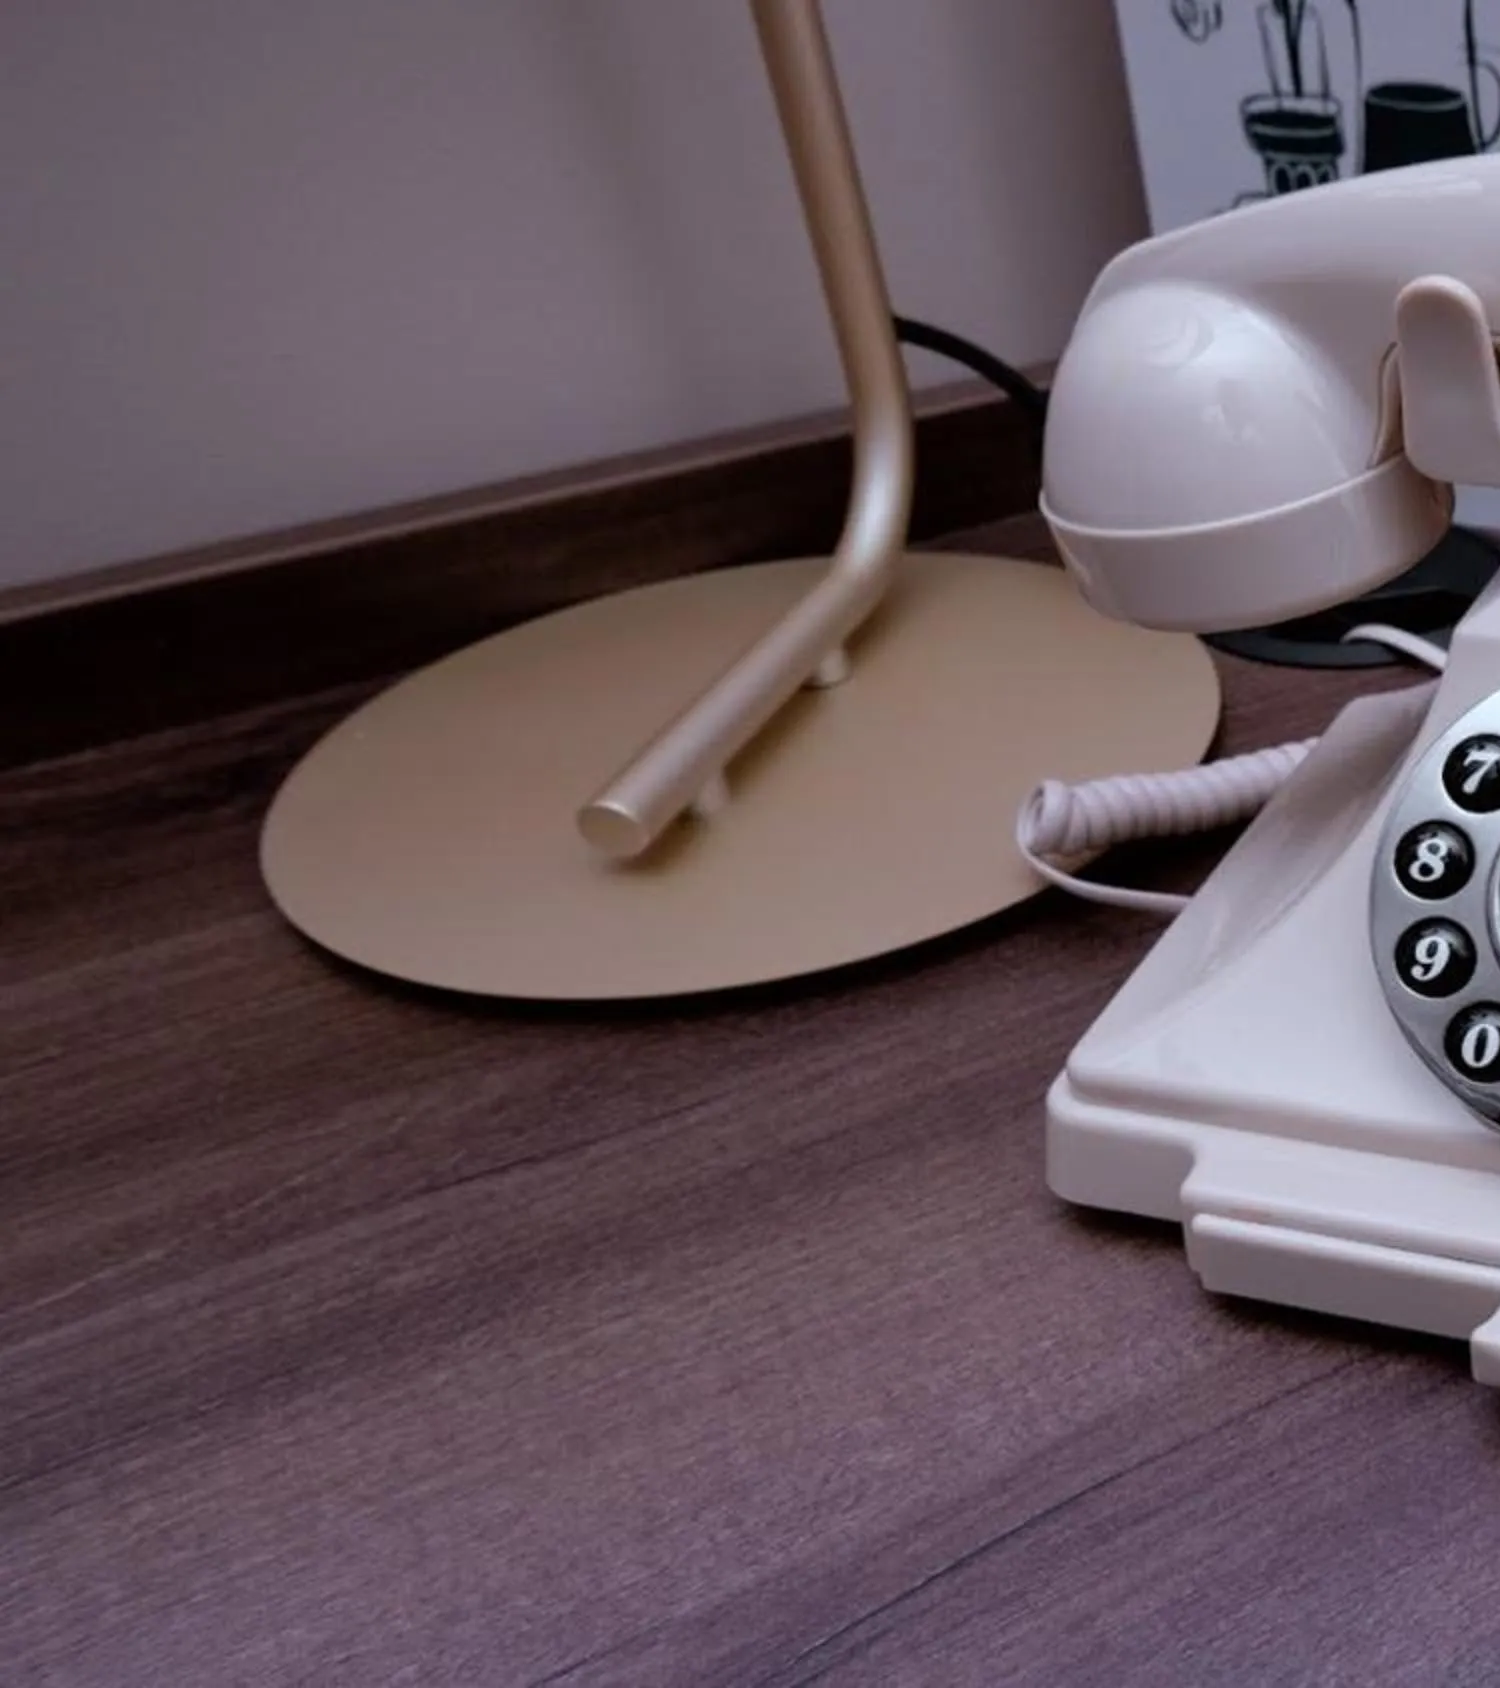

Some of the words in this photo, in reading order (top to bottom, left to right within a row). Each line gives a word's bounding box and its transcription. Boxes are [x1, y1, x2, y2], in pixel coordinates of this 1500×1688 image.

[1463, 749, 1500, 794] 7
[1409, 837, 1448, 882] 8
[1410, 935, 1451, 981] 9
[1461, 1023, 1500, 1069] 0
